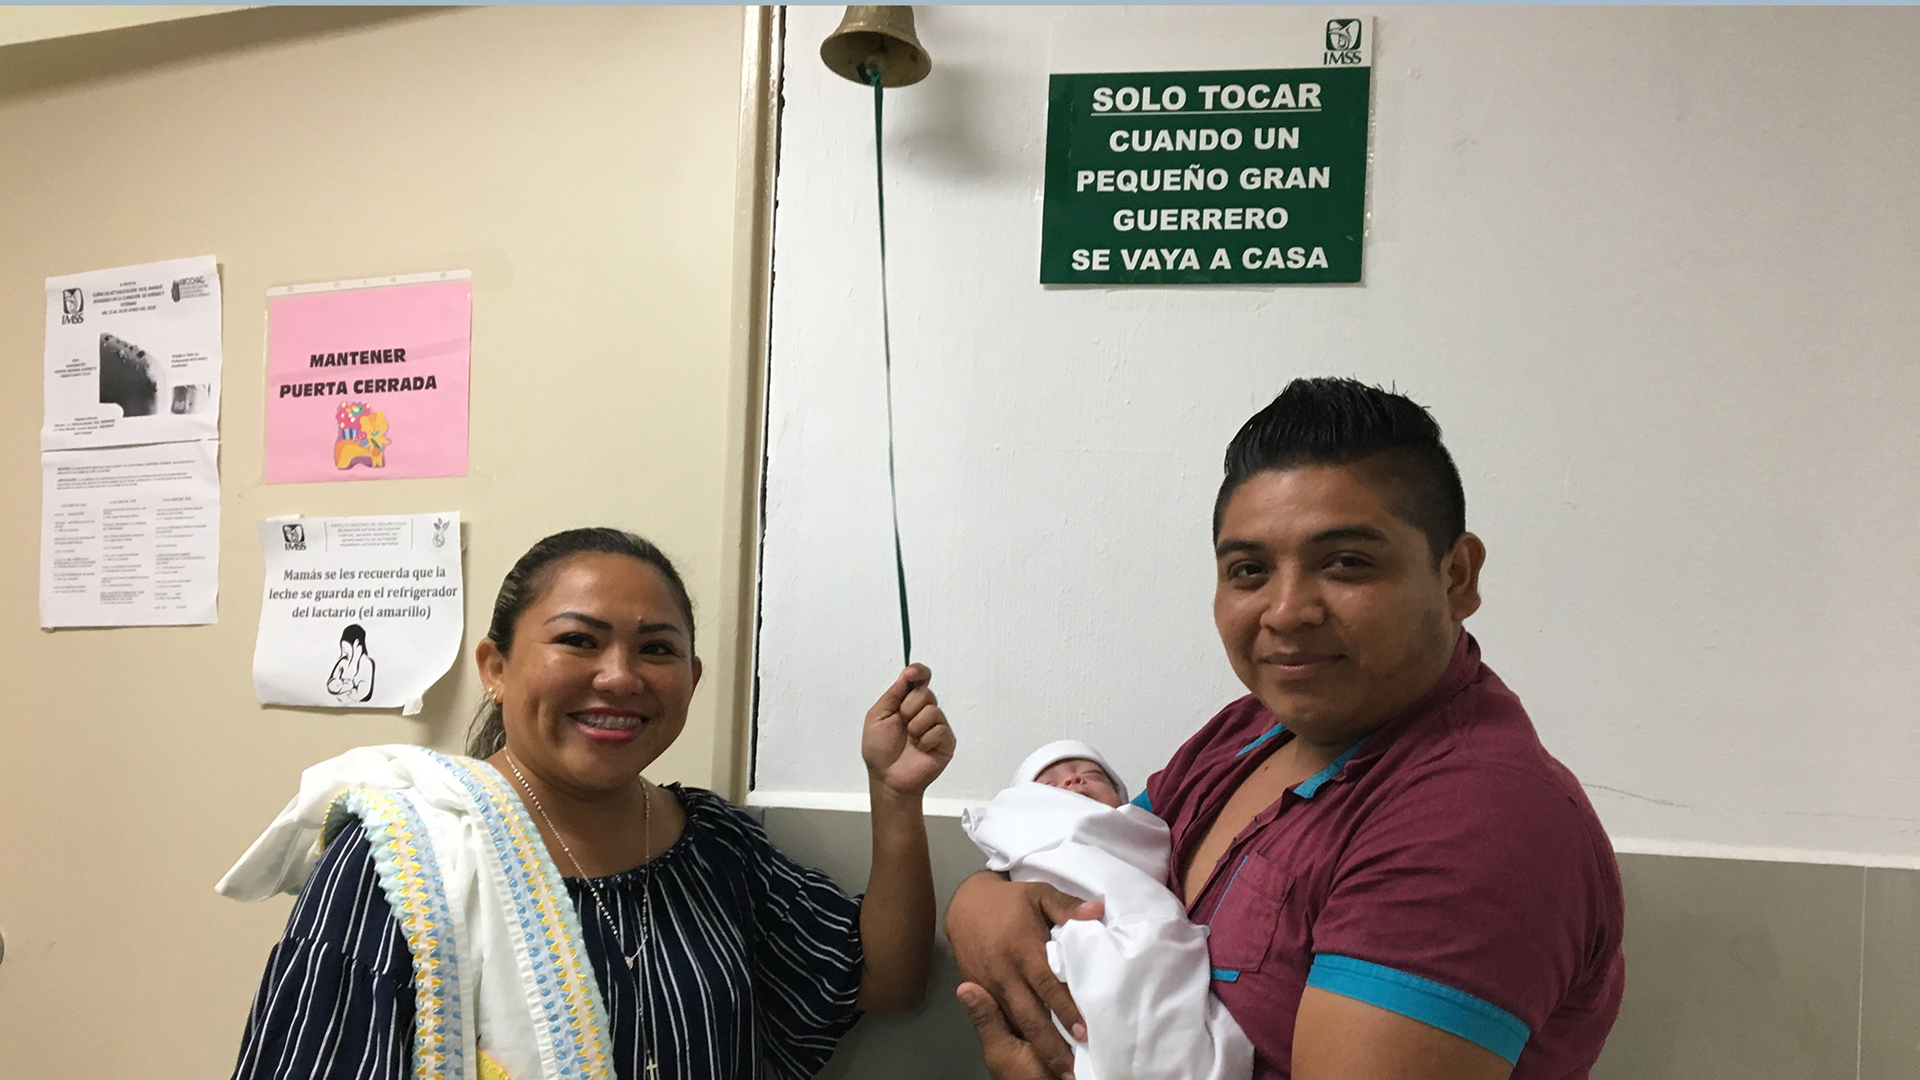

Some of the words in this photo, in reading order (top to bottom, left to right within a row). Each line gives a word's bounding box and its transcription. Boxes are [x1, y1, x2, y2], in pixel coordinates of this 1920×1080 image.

[1324, 49, 1361, 65] IMSS
[1093, 86, 1186, 111] SOLO
[1199, 83, 1321, 109] TOCAR
[1110, 129, 1242, 152] CUANDO
[1255, 127, 1299, 149] UN
[1077, 164, 1228, 193] PEQUEÑO
[1240, 167, 1330, 189] GRAN
[1114, 208, 1288, 231] GUERRERO
[1072, 249, 1110, 270] SE
[1121, 249, 1200, 270] VAYA
[1210, 248, 1231, 269] A
[1243, 247, 1328, 269] CASA
[62, 314, 84, 325] IMSS
[310, 349, 405, 367] MANTENER
[280, 381, 347, 398] PUERTA
[354, 376, 437, 394] CERRADA
[284, 569, 322, 581] Mamás
[324, 571, 336, 579] se
[340, 568, 355, 579] les
[358, 567, 409, 579] recuerda
[413, 569, 433, 581] que
[436, 566, 445, 577] la
[269, 588, 298, 599] leche
[302, 590, 312, 599] se
[315, 588, 354, 601] guarda
[358, 589, 371, 597] en
[374, 587, 384, 597] el
[387, 586, 457, 600] refrigerador
[292, 607, 308, 618] del
[312, 606, 355, 618] lactario
[359, 606, 374, 620] (el
[376, 605, 431, 619] amarillo)
